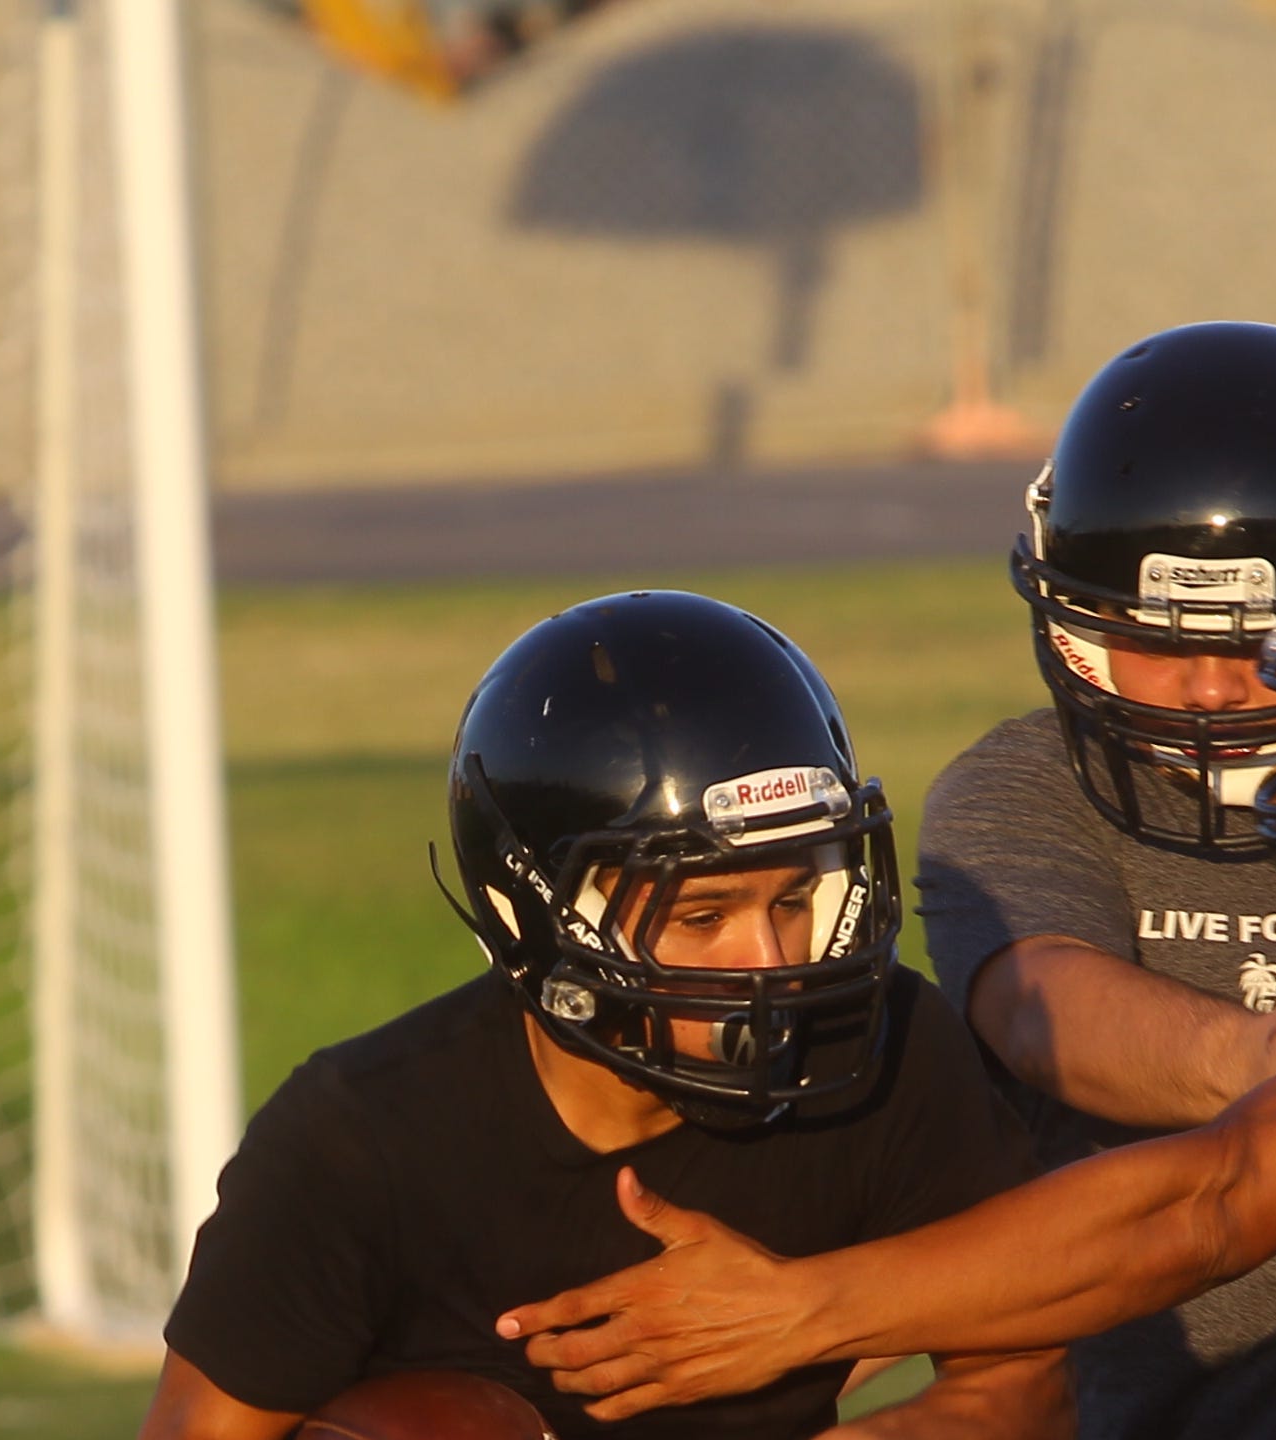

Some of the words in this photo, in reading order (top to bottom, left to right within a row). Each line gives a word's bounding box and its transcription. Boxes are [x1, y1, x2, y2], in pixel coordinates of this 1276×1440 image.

[1052, 634, 1104, 686] Ridde
[737, 772, 807, 805] Riddell
[1138, 909, 1229, 942] LIVE
